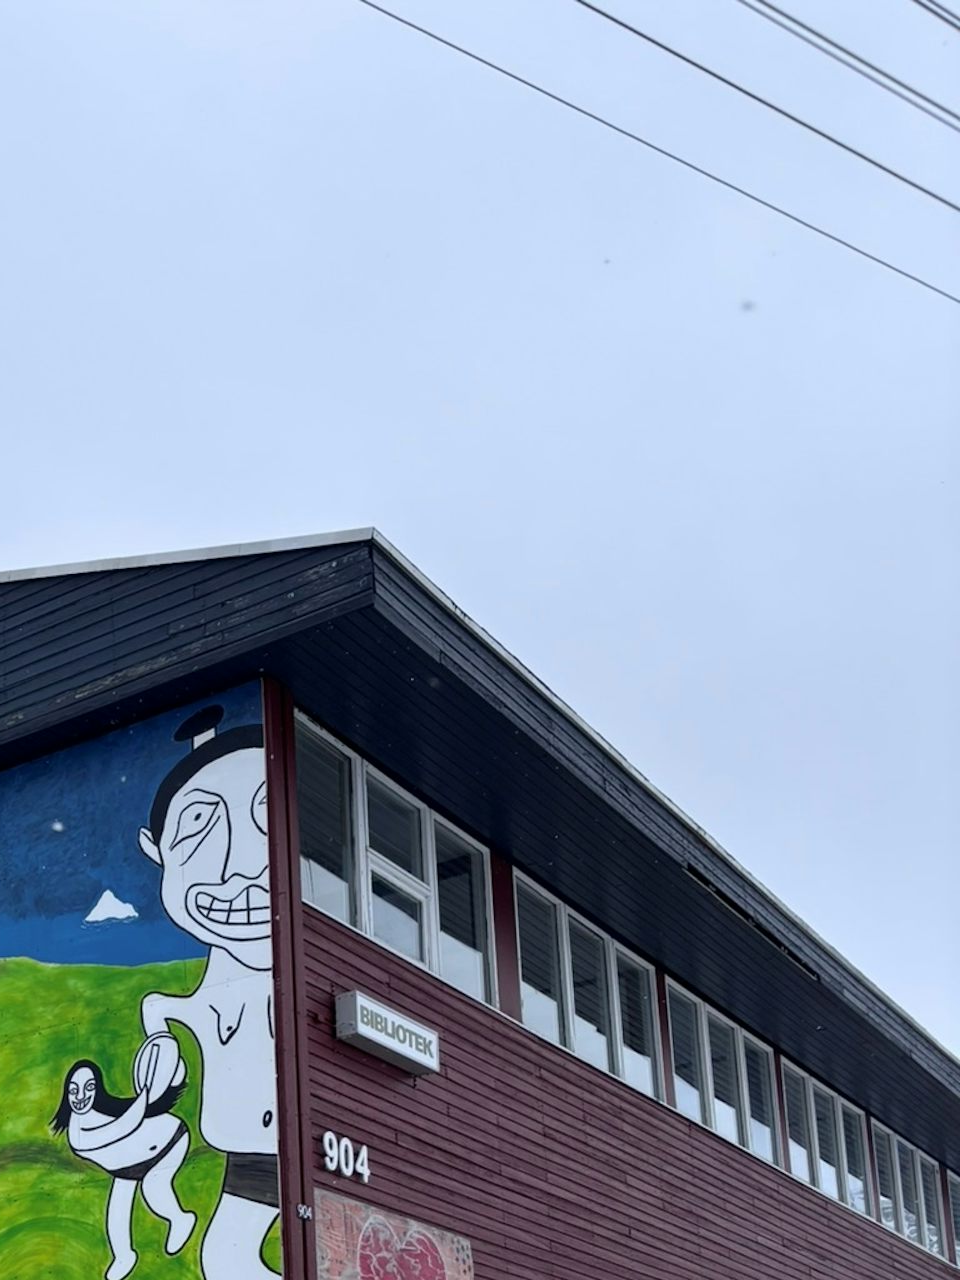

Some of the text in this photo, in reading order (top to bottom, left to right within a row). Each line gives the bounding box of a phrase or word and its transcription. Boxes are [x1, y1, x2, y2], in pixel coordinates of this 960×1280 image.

[360, 1004, 435, 1059] BIBLIOTEK
[323, 1131, 370, 1184] 904
[297, 1203, 312, 1220] 904
